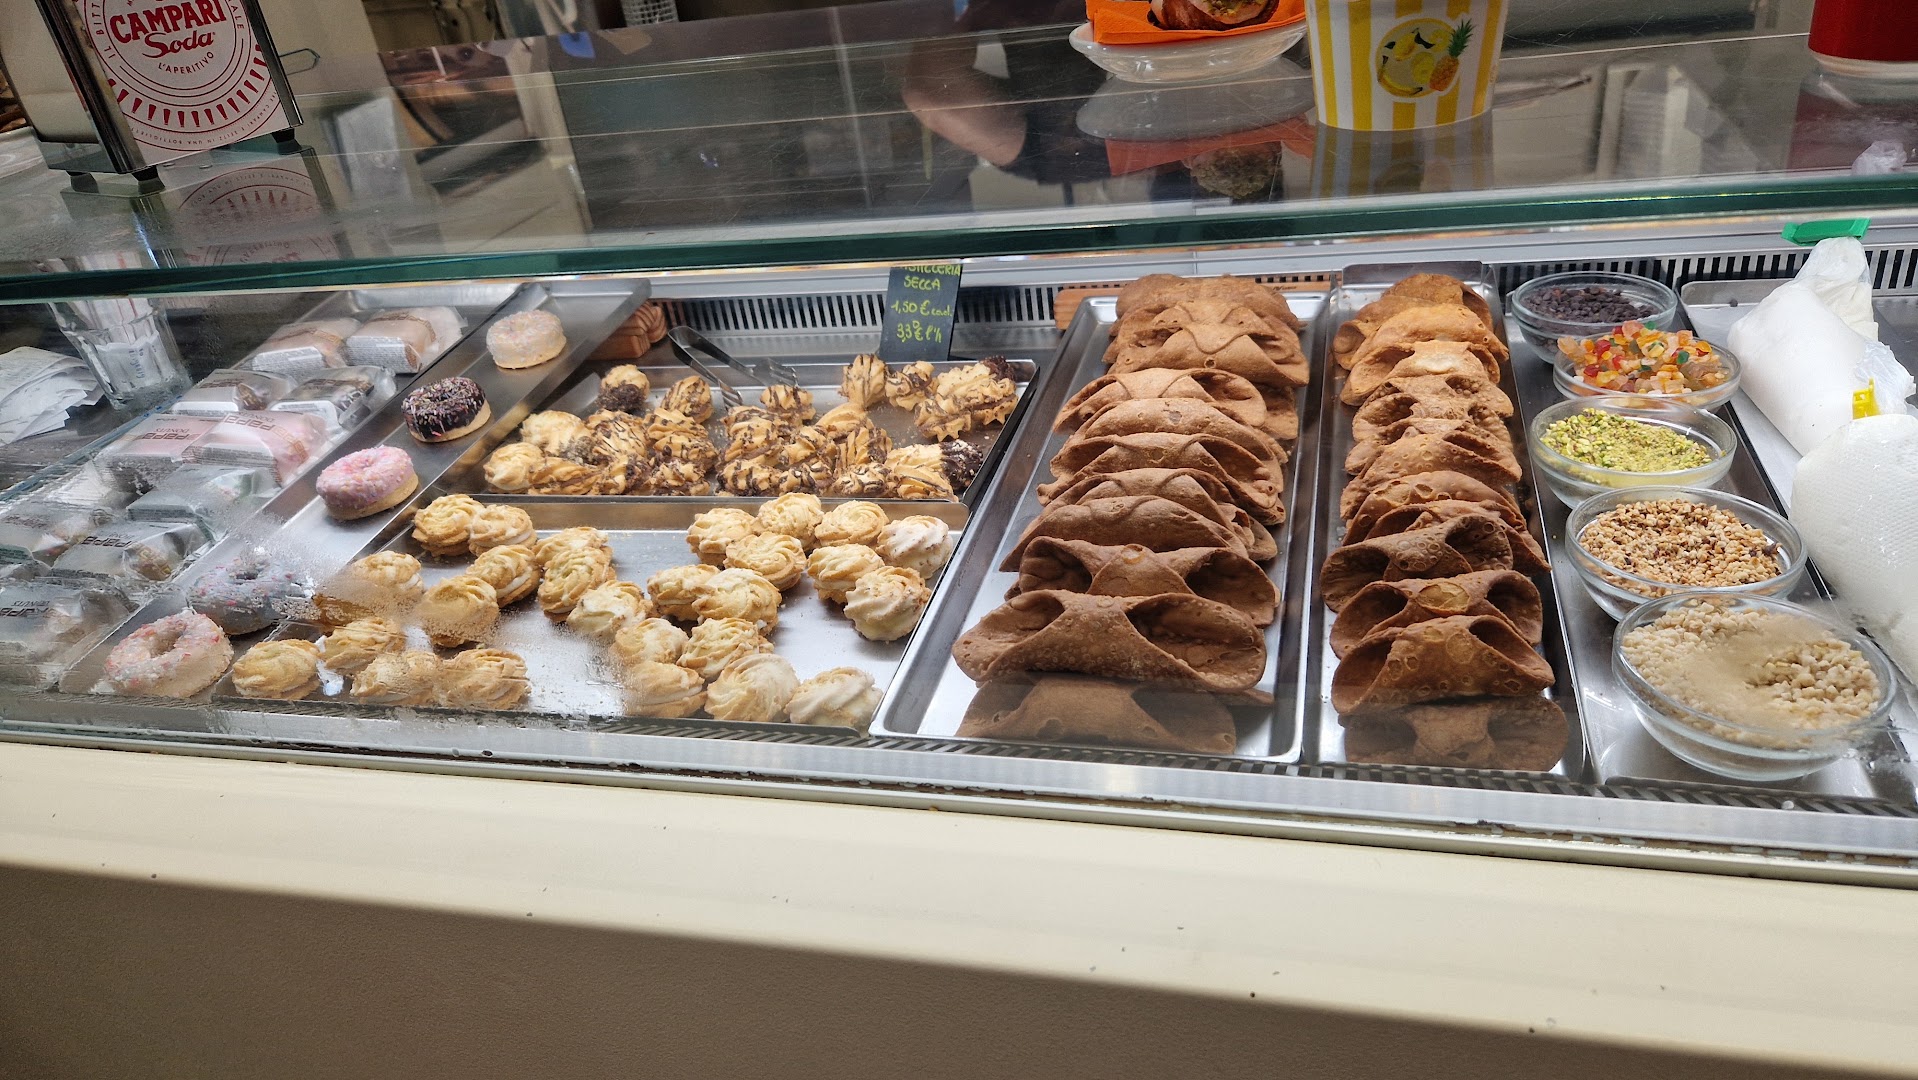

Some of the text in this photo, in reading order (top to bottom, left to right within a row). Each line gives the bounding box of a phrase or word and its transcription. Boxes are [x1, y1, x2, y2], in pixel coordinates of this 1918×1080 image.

[110, 0, 227, 43] CAMPARI
[142, 30, 214, 58] Soda
[158, 51, 214, 74] L'APERITIVO
[903, 275, 941, 291] SECCA
[890, 300, 918, 314] 1,50
